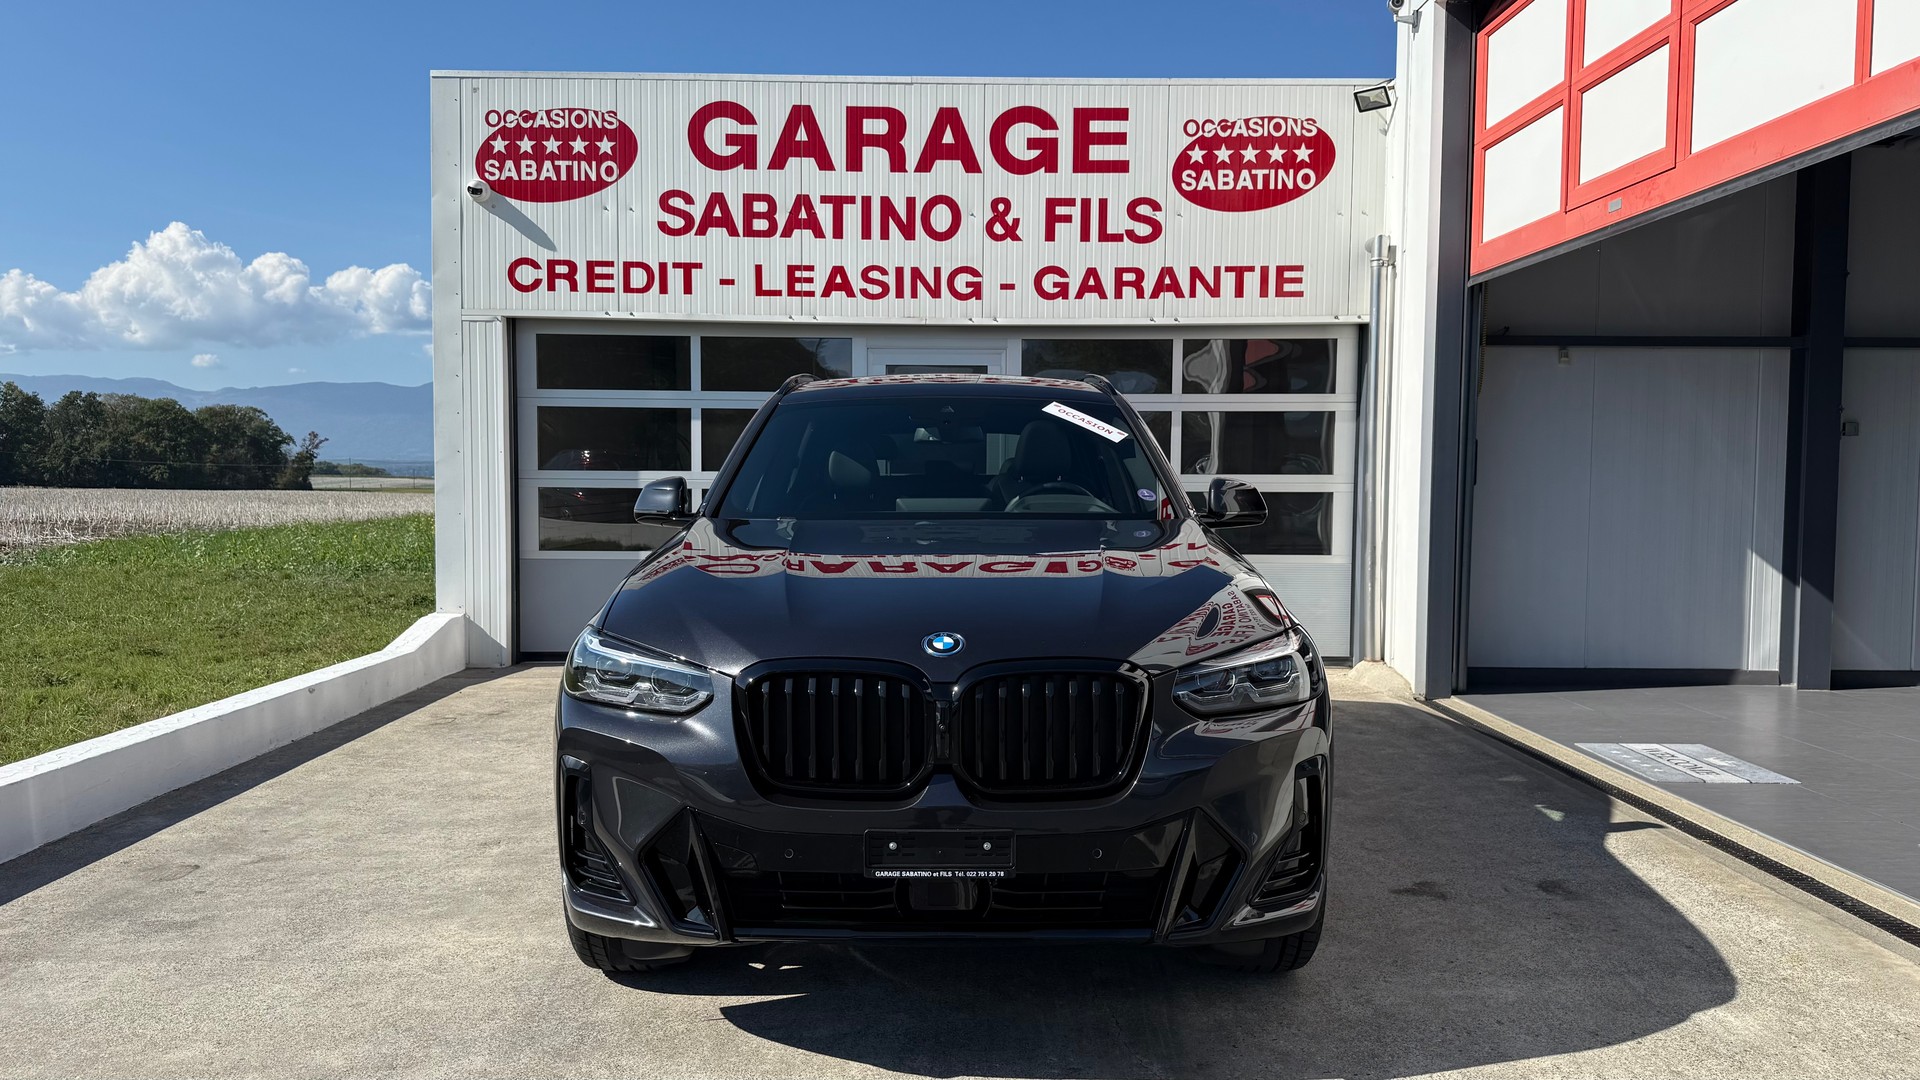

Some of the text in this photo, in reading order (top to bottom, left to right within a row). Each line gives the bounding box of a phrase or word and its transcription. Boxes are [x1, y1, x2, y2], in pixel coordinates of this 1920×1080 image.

[485, 109, 620, 129] OCCASIONS
[1182, 117, 1318, 138] OCCASIONS
[687, 100, 1130, 177] GARAGE
[484, 160, 620, 182] SABATINO
[1181, 168, 1317, 190] SABATINO
[657, 189, 1163, 245] SABATINO & FILS
[507, 257, 1305, 301] CREDIT - LEASING - GARANTIE
[1058, 408, 1114, 435] OCCASION
